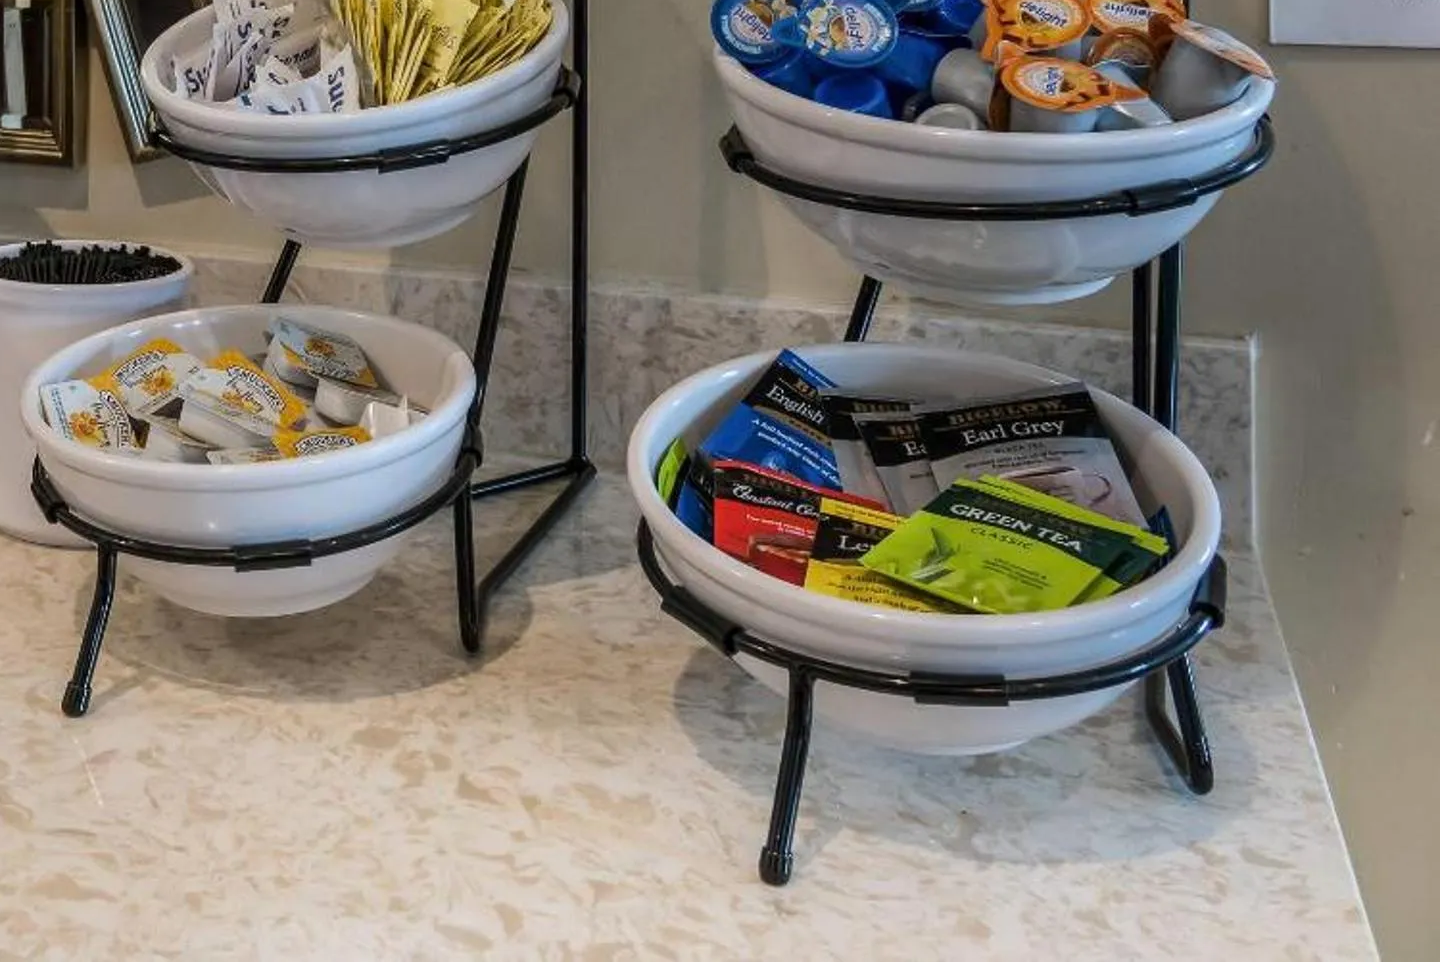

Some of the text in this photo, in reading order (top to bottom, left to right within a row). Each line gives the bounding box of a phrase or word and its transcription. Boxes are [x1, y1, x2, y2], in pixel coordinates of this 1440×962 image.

[1020, 1, 1068, 28] delight
[766, 384, 825, 425] English
[962, 419, 1065, 446] Earl Grey
[949, 504, 1083, 552] GREEN TEA
[970, 526, 1034, 551] CLASSIC
[838, 535, 874, 552] Le
